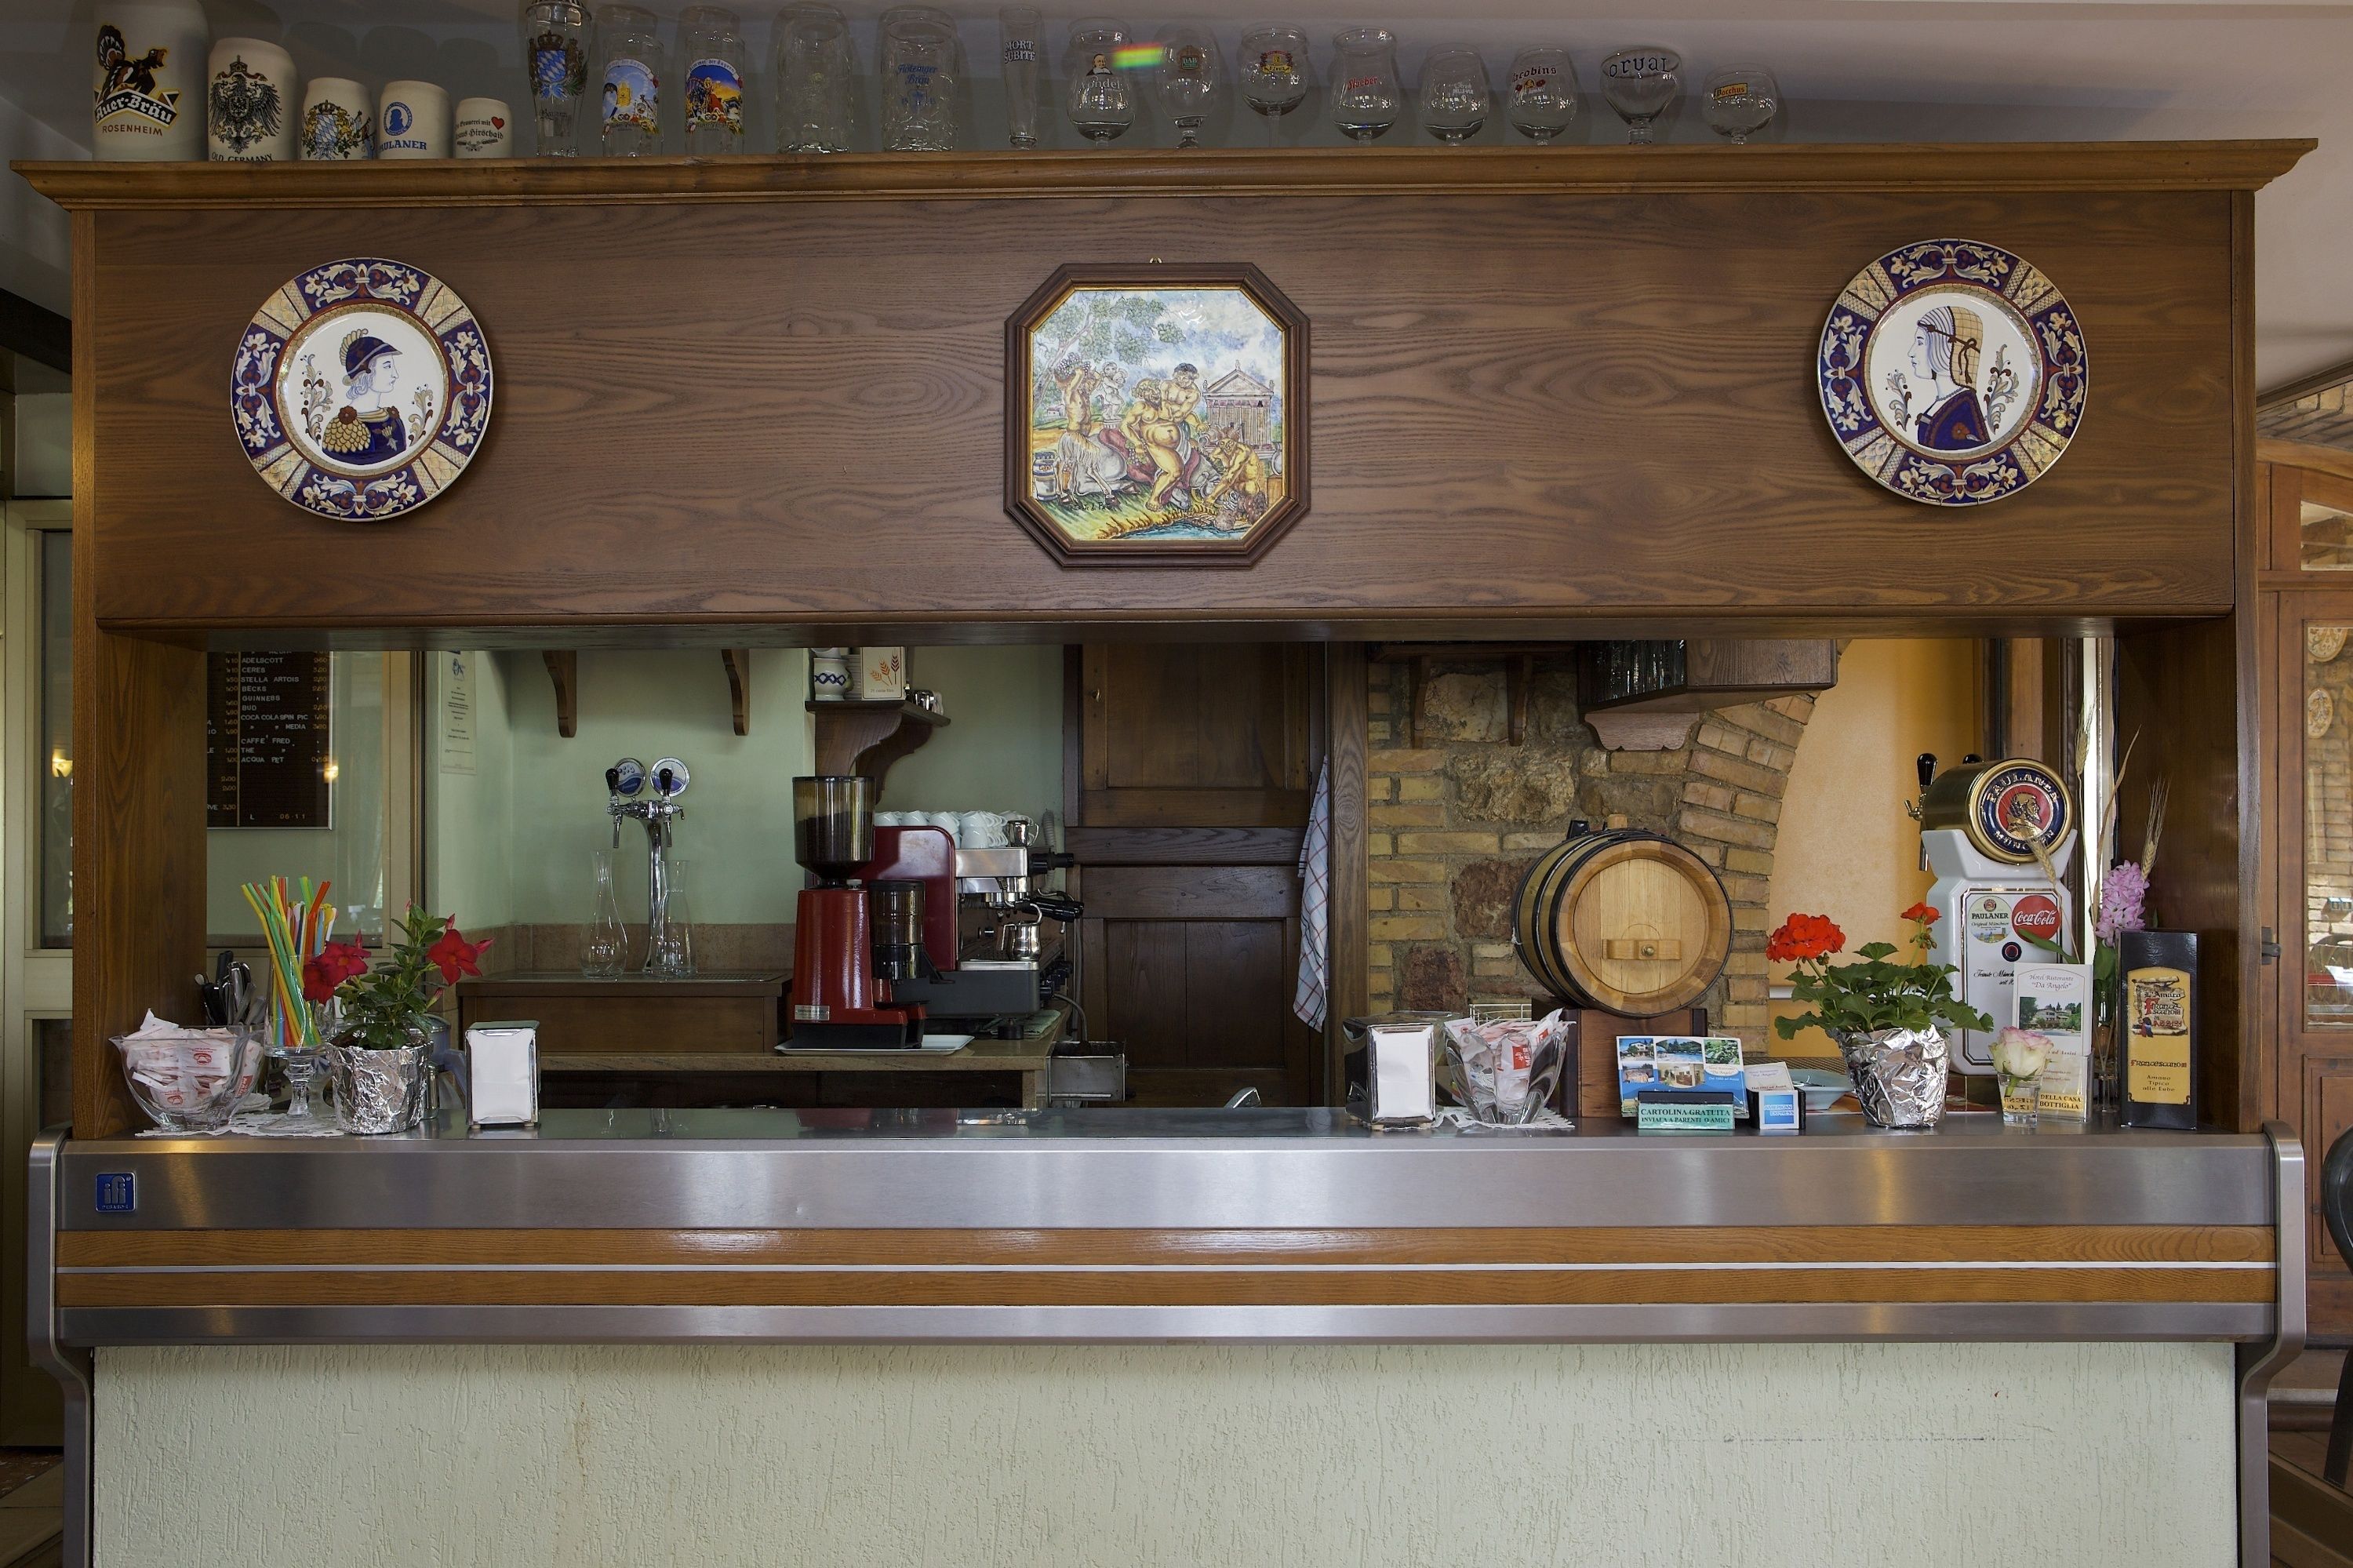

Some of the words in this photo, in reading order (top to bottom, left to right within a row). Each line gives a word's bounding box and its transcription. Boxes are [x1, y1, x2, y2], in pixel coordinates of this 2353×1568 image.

[1004, 40, 1035, 52] MORT
[1004, 51, 1035, 64] SUBITE
[102, 124, 163, 136] ROSENHEIM
[1986, 773, 2059, 803] PAULANER
[2013, 910, 2058, 926] Coca-Cola
[2039, 1101, 2079, 1110] BOTTIGLIA
